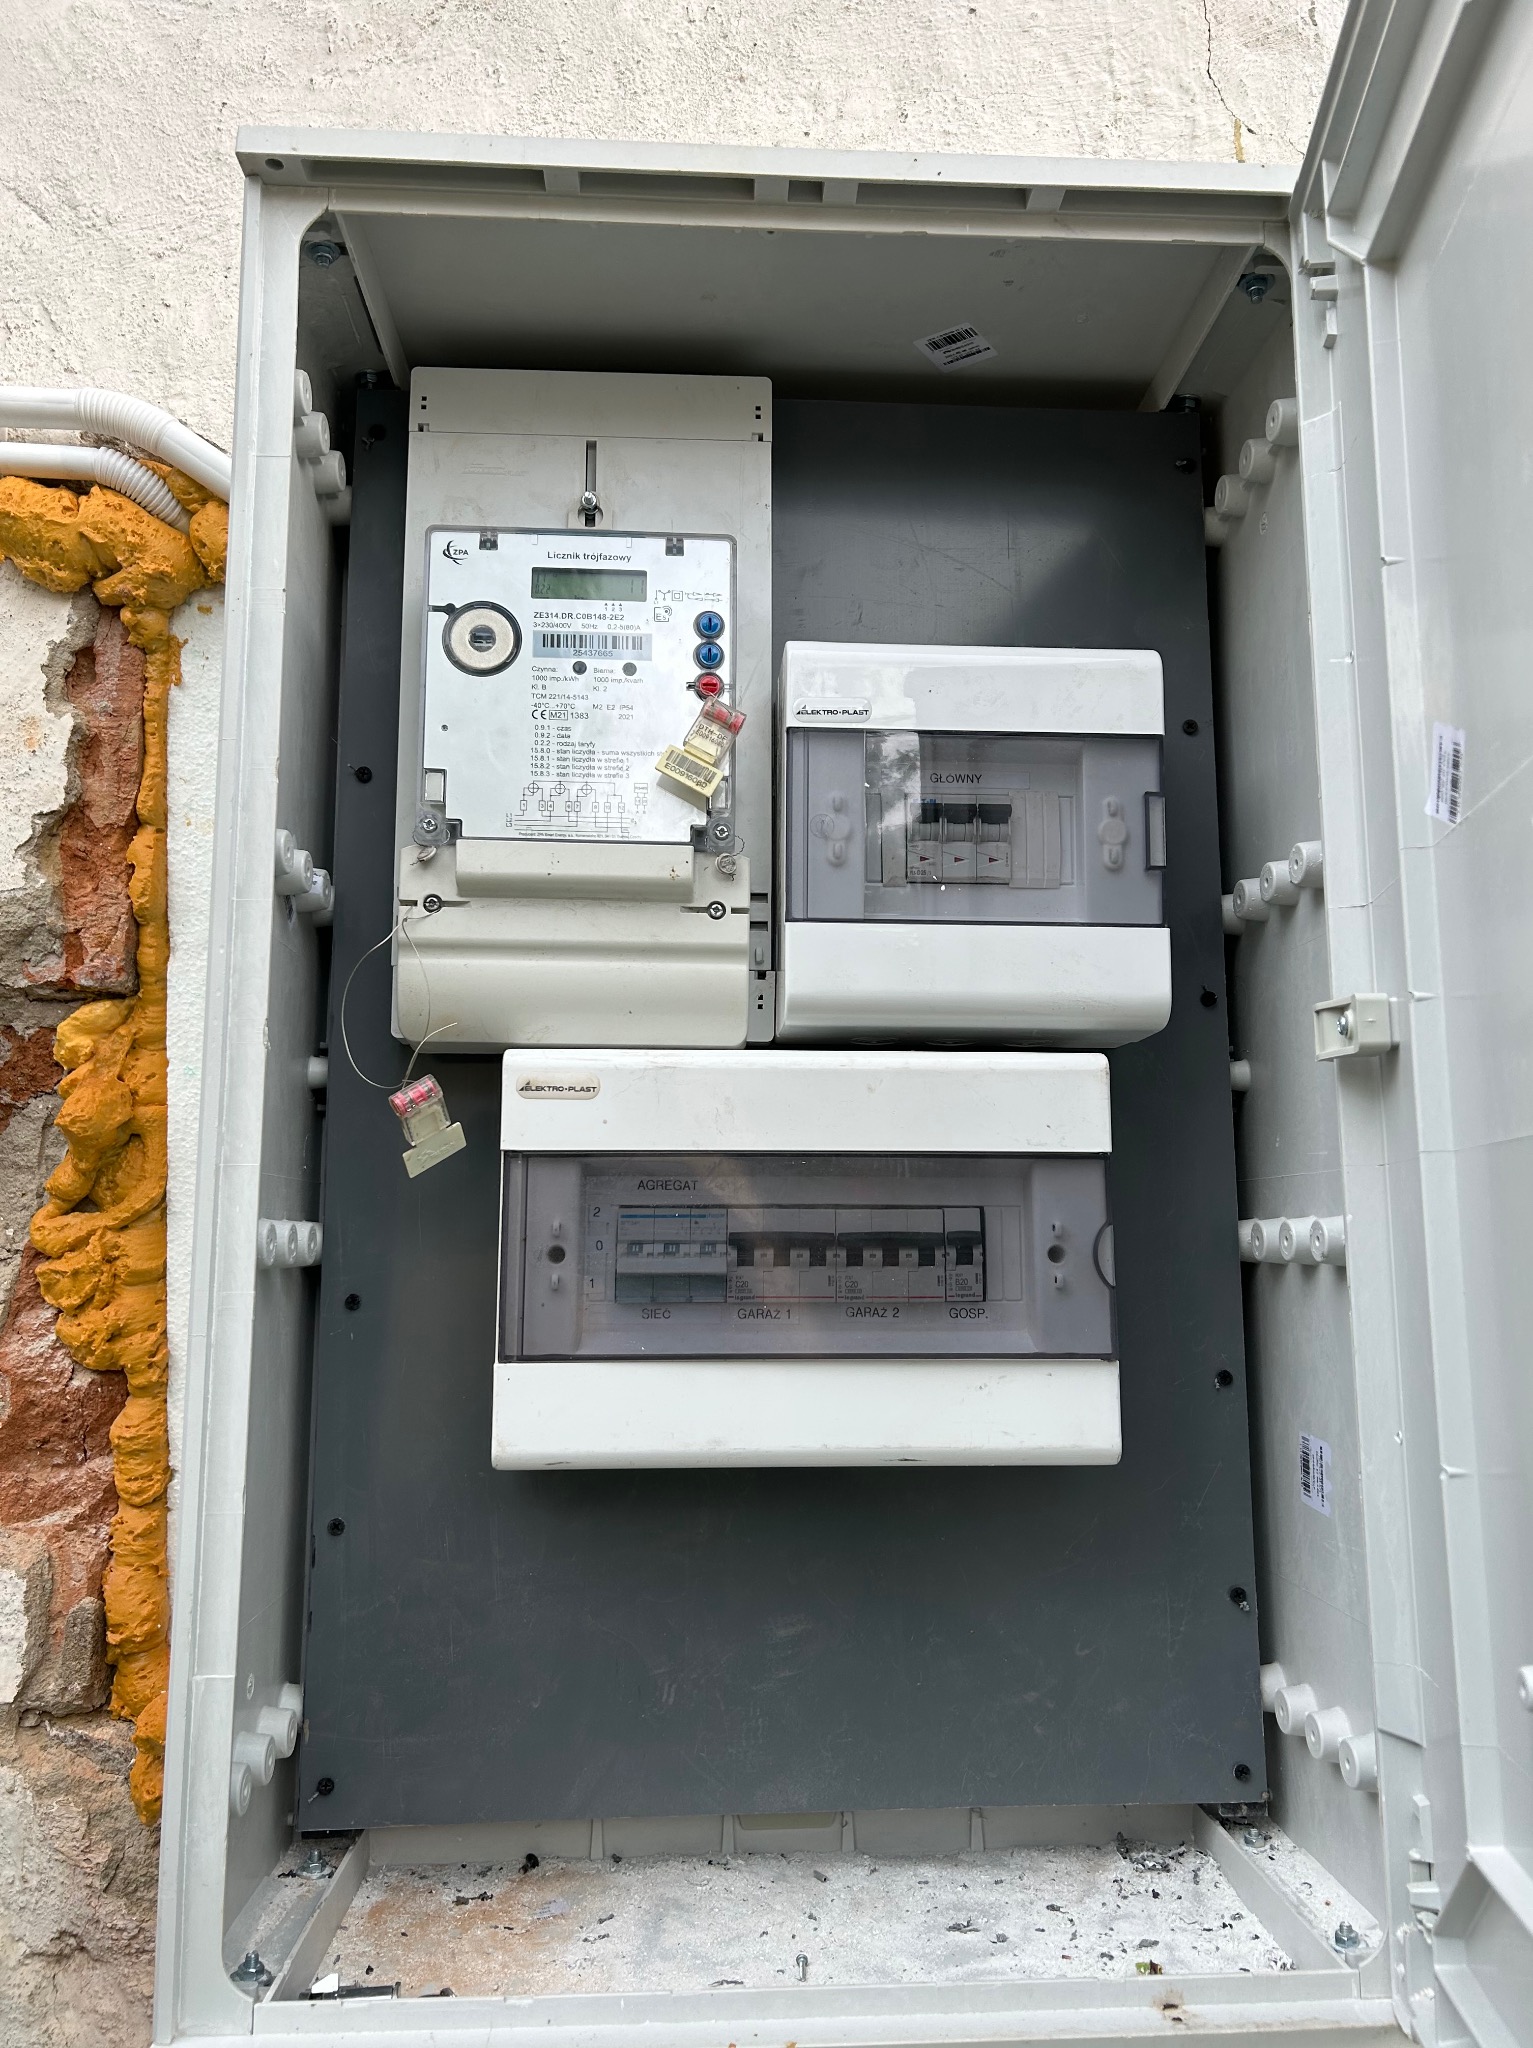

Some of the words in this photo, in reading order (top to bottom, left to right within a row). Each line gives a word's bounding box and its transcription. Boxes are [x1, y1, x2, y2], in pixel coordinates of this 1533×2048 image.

[547, 551, 580, 559] Licznik
[583, 553, 631, 562] trójfazowy
[531, 665, 558, 673] Czynna:
[550, 711, 567, 719] M21
[556, 740, 577, 748] rodzaj
[637, 1179, 698, 1191] AGREGAT
[593, 1206, 601, 1218] 2
[595, 1240, 604, 1251] 0
[590, 1278, 594, 1288] 1
[955, 1278, 969, 1286] B20
[641, 1307, 671, 1320] SIEĆ
[737, 1308, 781, 1320] GARAŻ
[786, 1309, 791, 1320] 1
[845, 1306, 888, 1318] GARAŻ
[892, 1306, 900, 1318] 2
[949, 1307, 989, 1319] GOSP.
